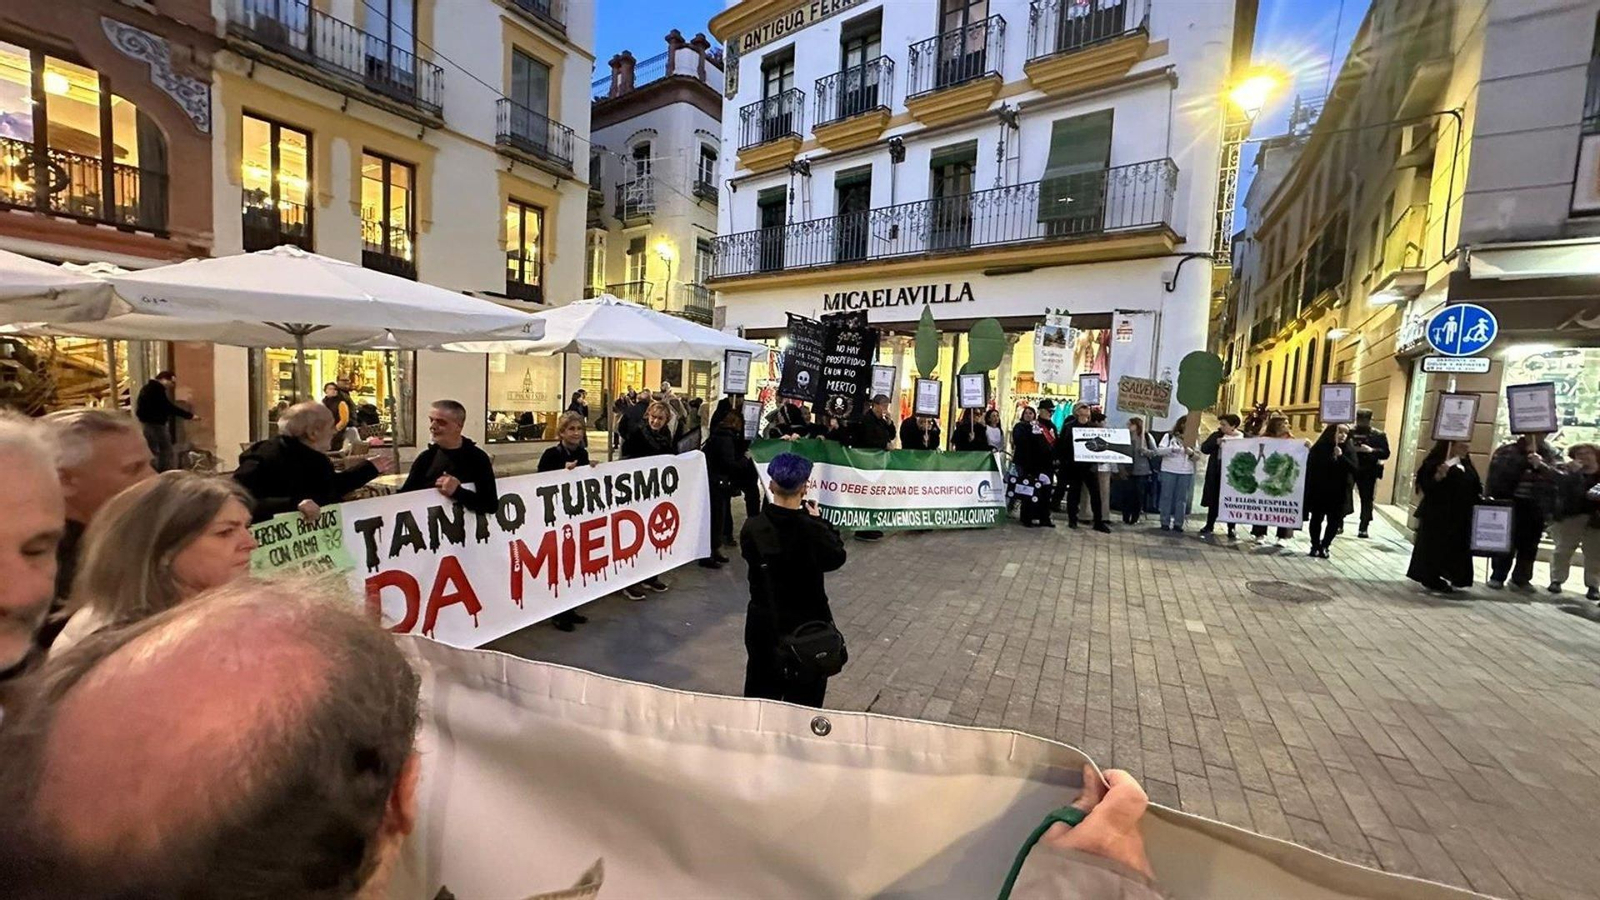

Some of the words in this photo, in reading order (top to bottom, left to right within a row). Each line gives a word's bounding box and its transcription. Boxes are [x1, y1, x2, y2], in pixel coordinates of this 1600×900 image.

[744, 10, 804, 49] ANTIGUA
[823, 282, 975, 311] MICAELAVILLA
[836, 345, 845, 353] NO
[846, 345, 861, 355] HAY
[823, 366, 832, 376] EN
[833, 368, 842, 376] UN
[826, 380, 857, 395] MUERTO
[820, 480, 838, 492] NO
[840, 483, 868, 495] DEBE
[870, 485, 886, 495] SER
[888, 486, 906, 496] ZONA
[908, 486, 919, 496] DE
[922, 486, 974, 496] SACRIFICIO
[1224, 503, 1261, 511] NOSOTROS
[1258, 499, 1299, 507] RESPIRAN
[354, 492, 527, 573] TANTO
[536, 465, 680, 527] TURISMO
[922, 510, 934, 526] EL
[1229, 511, 1242, 519] NO
[1245, 512, 1296, 524] TALEMOS
[269, 544, 292, 567] CON
[293, 535, 320, 559] ALMA
[364, 555, 482, 639] DA
